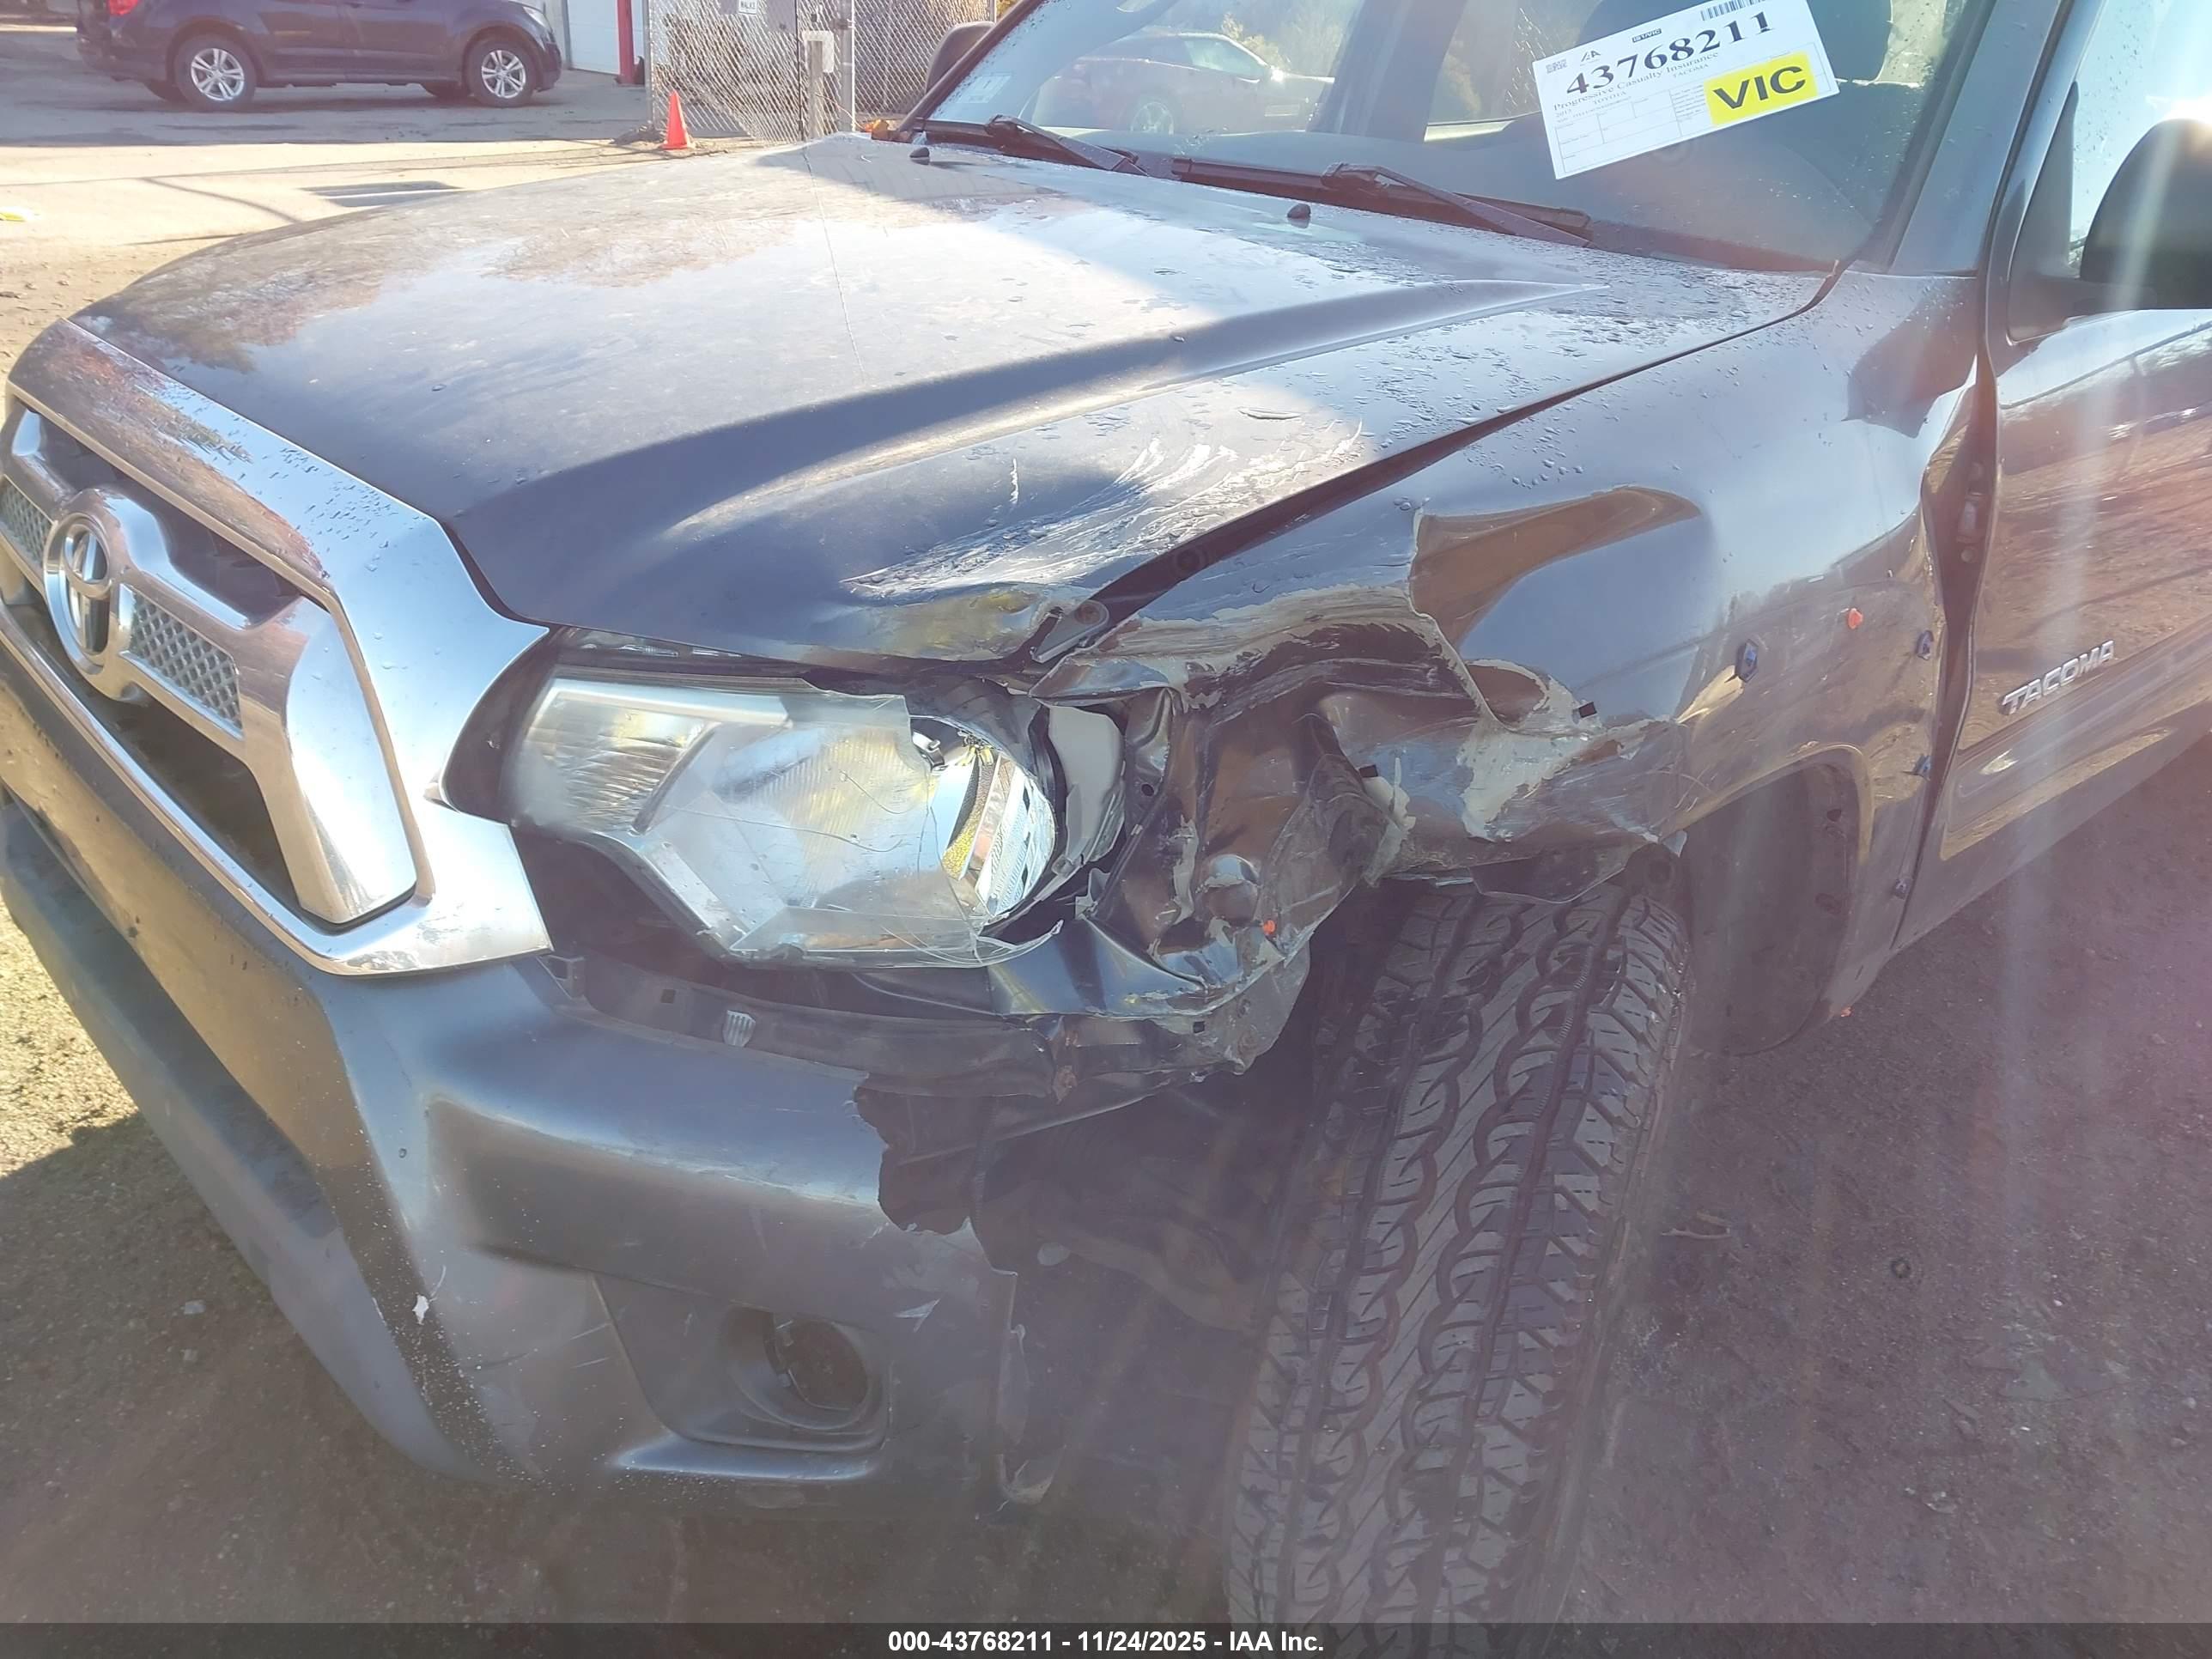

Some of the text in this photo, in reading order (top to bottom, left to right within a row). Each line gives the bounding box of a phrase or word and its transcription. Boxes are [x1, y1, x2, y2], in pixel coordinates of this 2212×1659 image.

[1553, 88, 1614, 111] Progressive
[1617, 71, 1662, 89] Casualty
[1667, 52, 1718, 73] Insurance
[1567, 11, 1775, 94] 43768211
[1593, 91, 1626, 105] TOYOTA
[1674, 64, 1709, 78] TACOMA
[1713, 66, 1806, 109] VIC
[2001, 639, 2114, 714] TACOMA
